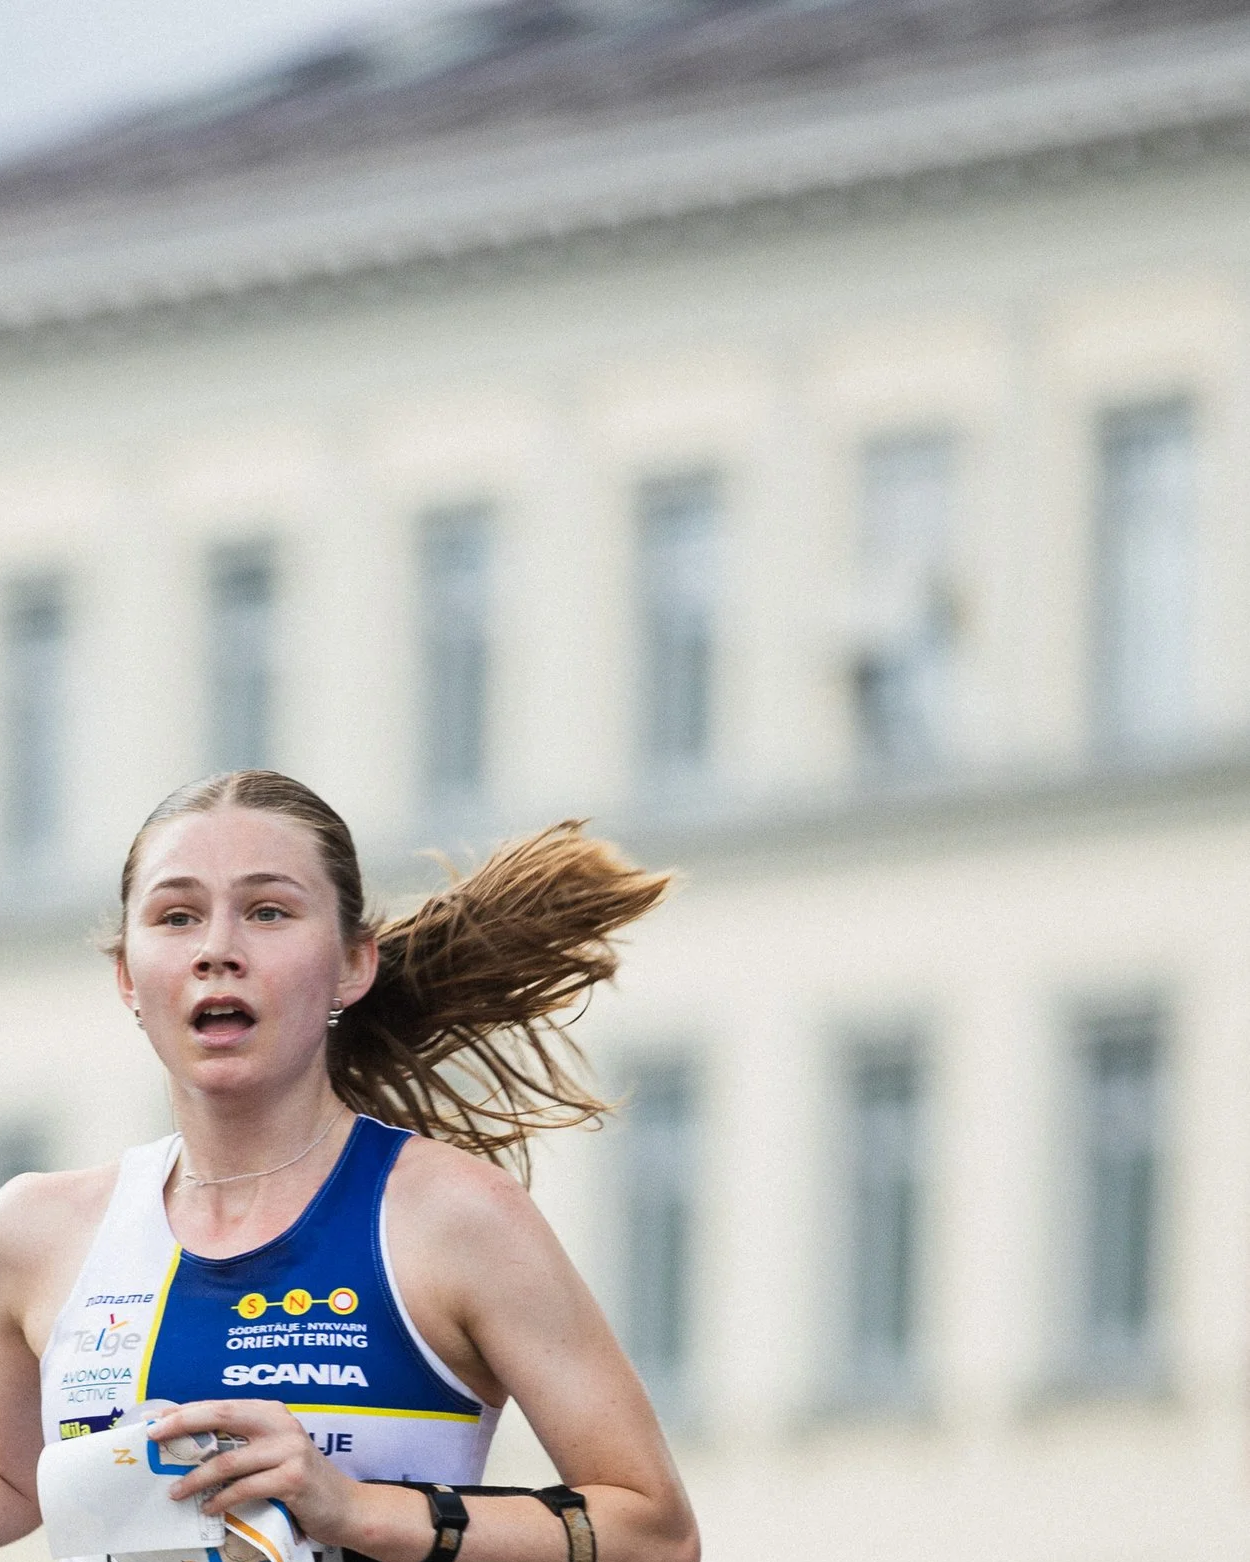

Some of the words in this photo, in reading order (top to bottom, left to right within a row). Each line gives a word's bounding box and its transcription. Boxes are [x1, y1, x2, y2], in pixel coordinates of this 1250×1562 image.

[74, 1328, 141, 1357] Telge
[226, 1333, 368, 1350] ORIENTERING
[62, 1367, 133, 1384] AVONOVA
[221, 1363, 369, 1387] SCANIA
[68, 1387, 117, 1403] ACTIVE
